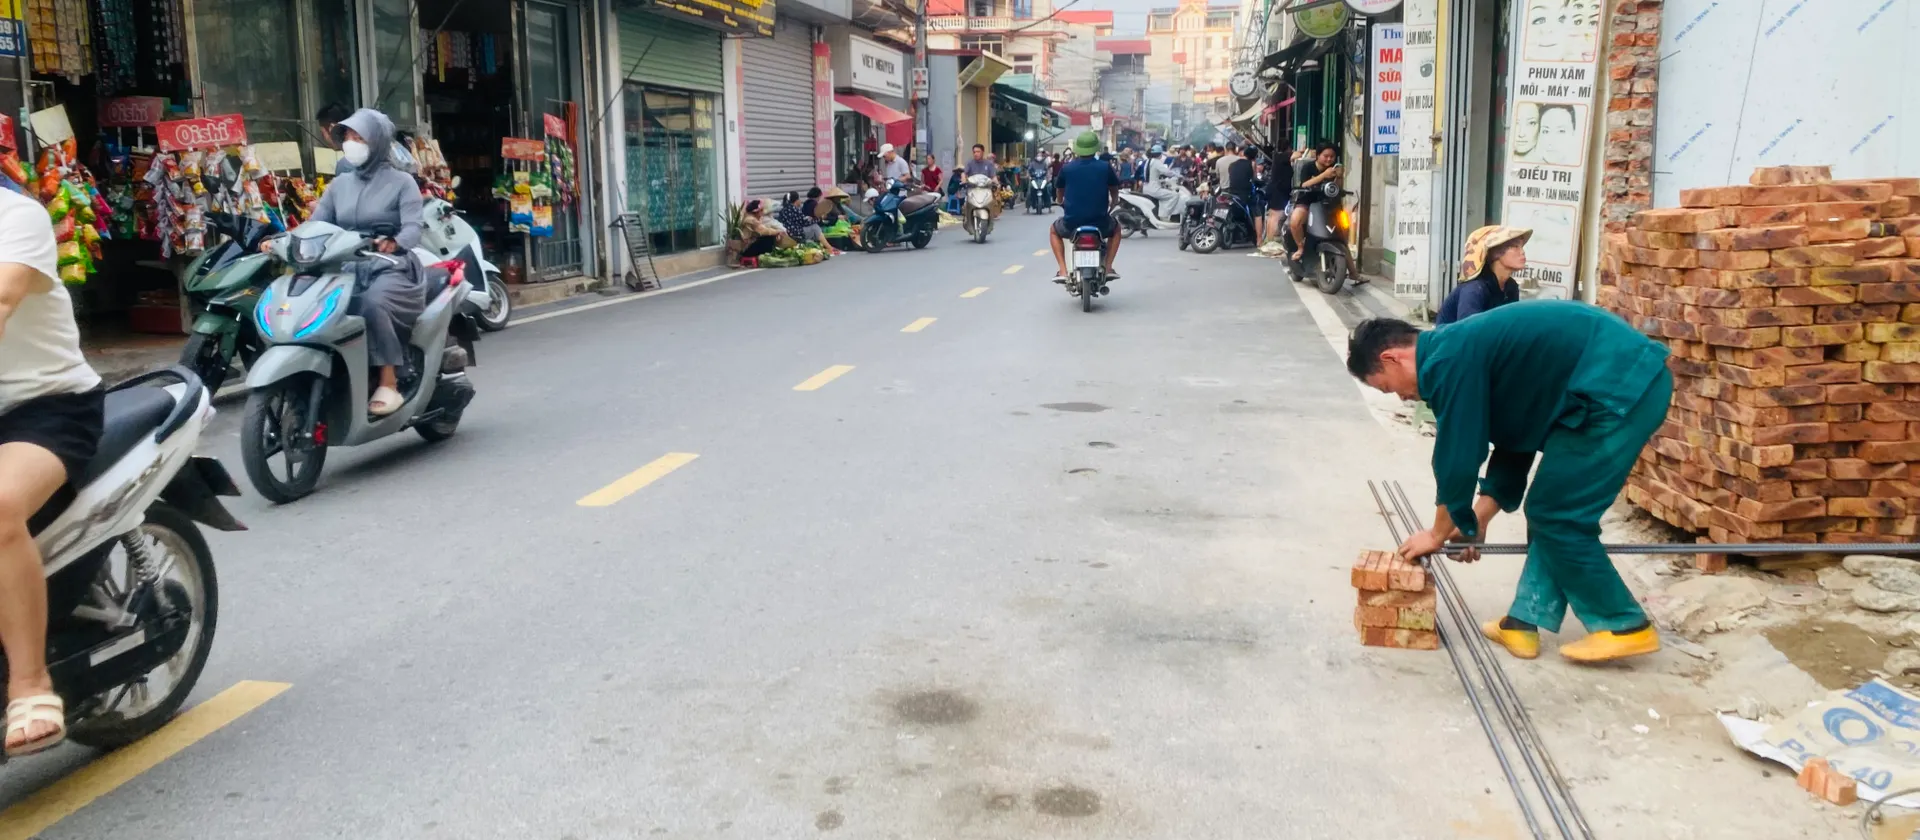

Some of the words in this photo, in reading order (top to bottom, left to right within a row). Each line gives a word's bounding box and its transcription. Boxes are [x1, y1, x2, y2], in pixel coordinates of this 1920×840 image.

[1528, 66, 1558, 80] PHUN
[108, 101, 148, 122] Oishi
[175, 122, 230, 146] Oishi
[1552, 171, 1572, 186] TRỊ
